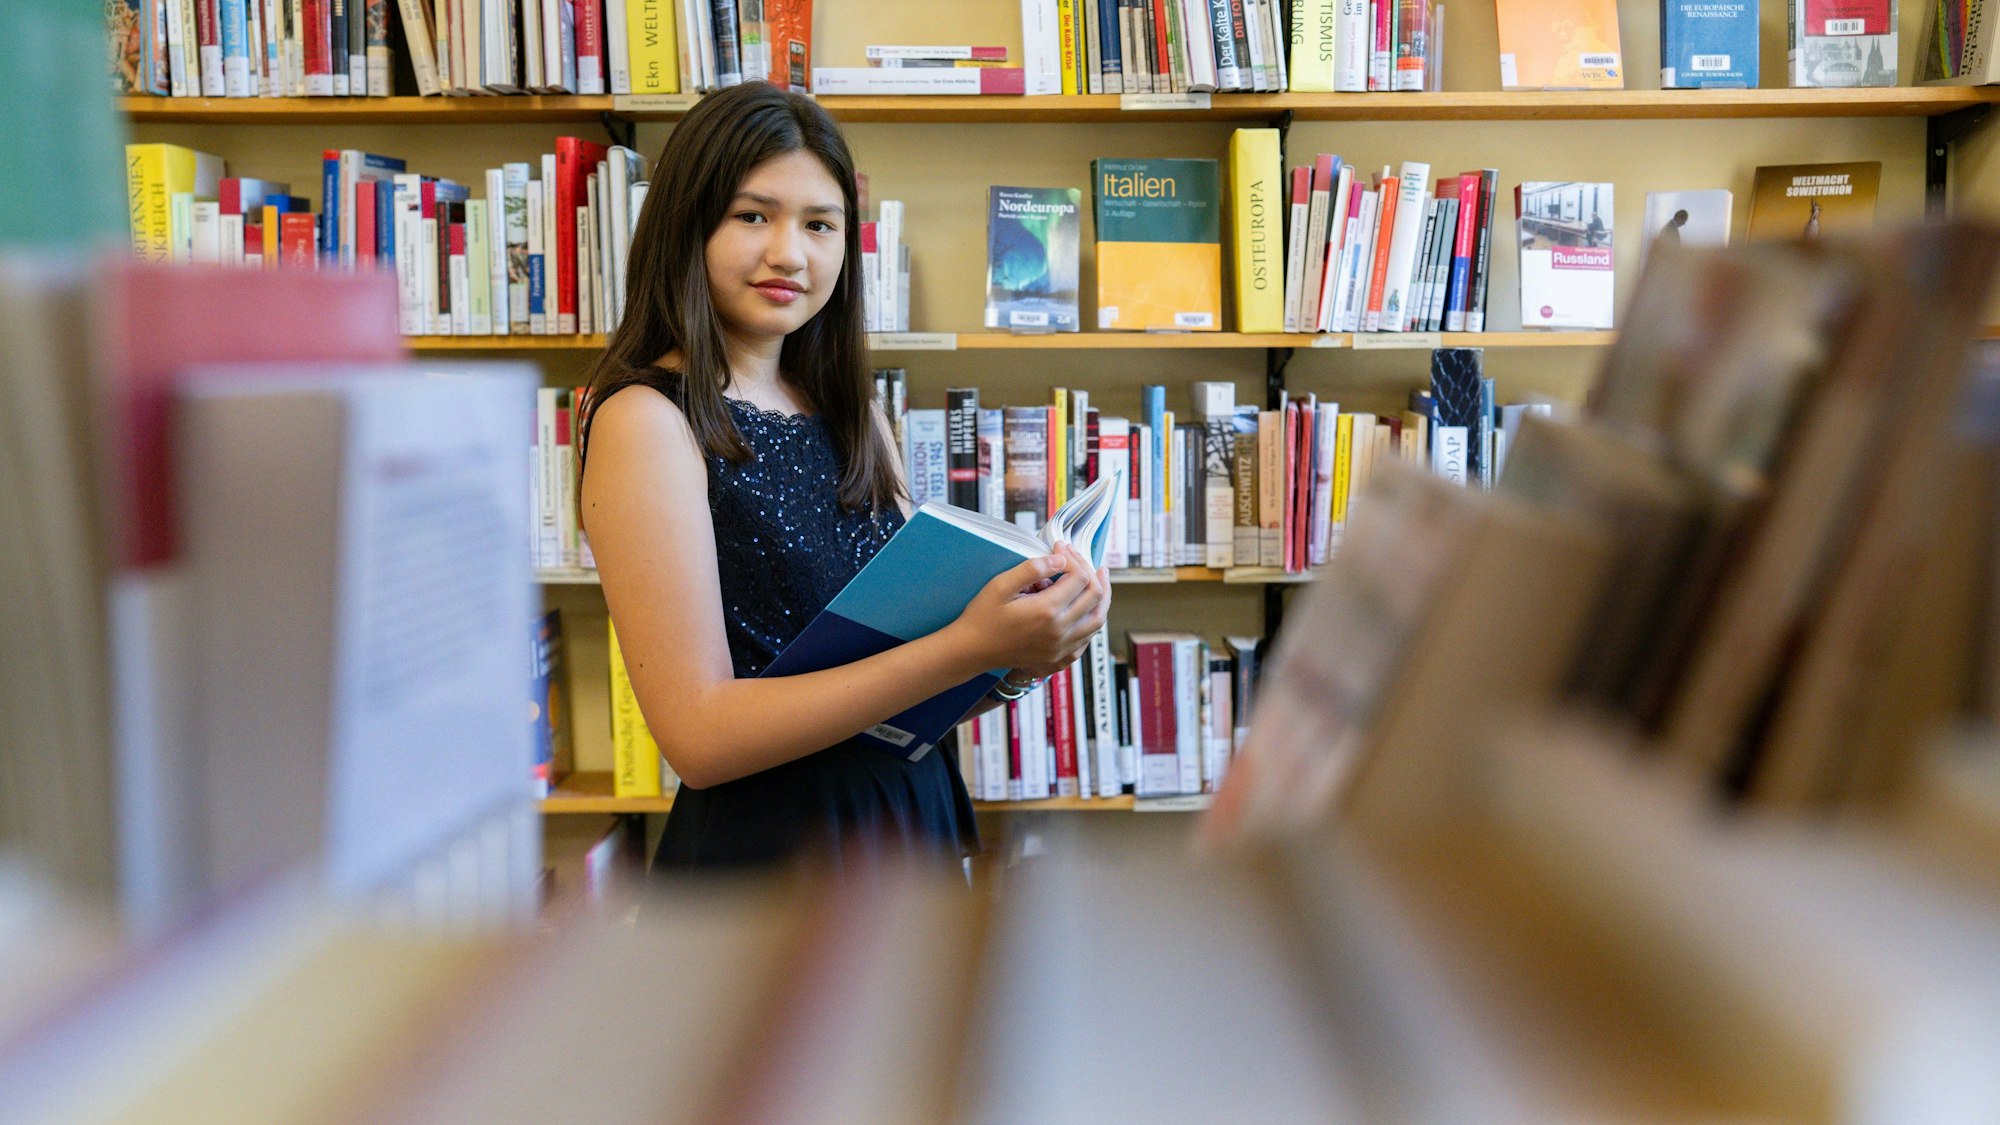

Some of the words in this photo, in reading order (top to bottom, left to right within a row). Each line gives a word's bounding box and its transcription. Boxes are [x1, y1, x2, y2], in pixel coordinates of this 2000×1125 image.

[1694, 3, 1745, 11] EUROPÄISCHE
[1063, 14, 1071, 27] Die
[1214, 10, 1230, 42] Kalte
[1232, 20, 1245, 39] DIE
[1063, 29, 1073, 70] Kuba-Krise
[1219, 45, 1233, 67] Der
[645, 60, 660, 88] Ekn
[1103, 172, 1176, 198] Italien
[1786, 184, 1853, 197] SOWJETUNION
[1792, 174, 1850, 187] WELTMACHT
[998, 199, 1075, 216] Nordeuropa
[1249, 180, 1268, 290] OSTEUROPA
[1553, 252, 1610, 266] Russland
[531, 257, 541, 297] Frankreich
[949, 408, 963, 454] HITLERS
[962, 398, 976, 454] IMPERIUM
[1238, 456, 1252, 526] AUSCHWITZ
